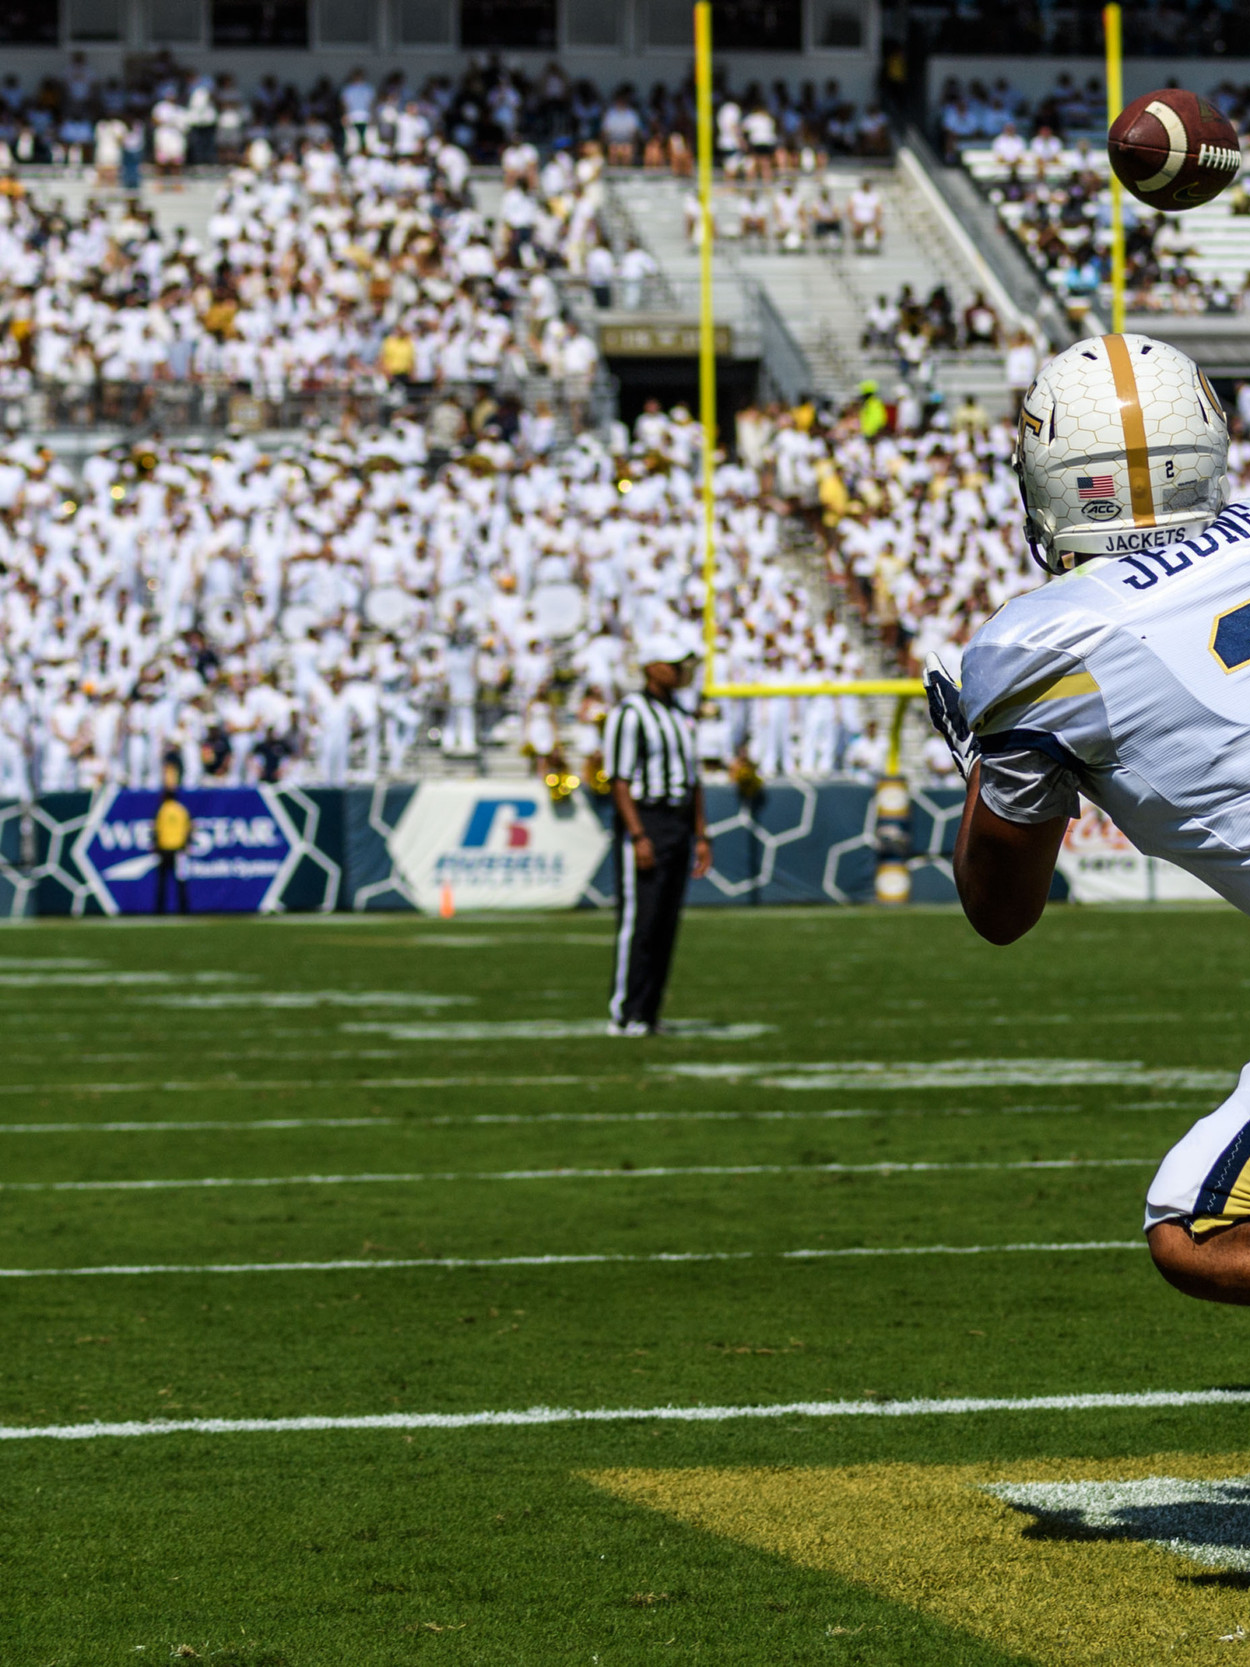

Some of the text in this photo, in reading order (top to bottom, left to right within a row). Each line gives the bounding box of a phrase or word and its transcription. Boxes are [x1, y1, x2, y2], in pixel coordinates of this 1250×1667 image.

[1165, 460, 1175, 479] 2
[1088, 504, 1115, 514] ACC
[1106, 527, 1186, 552] JACKETS
[98, 816, 280, 857] WESTAR
